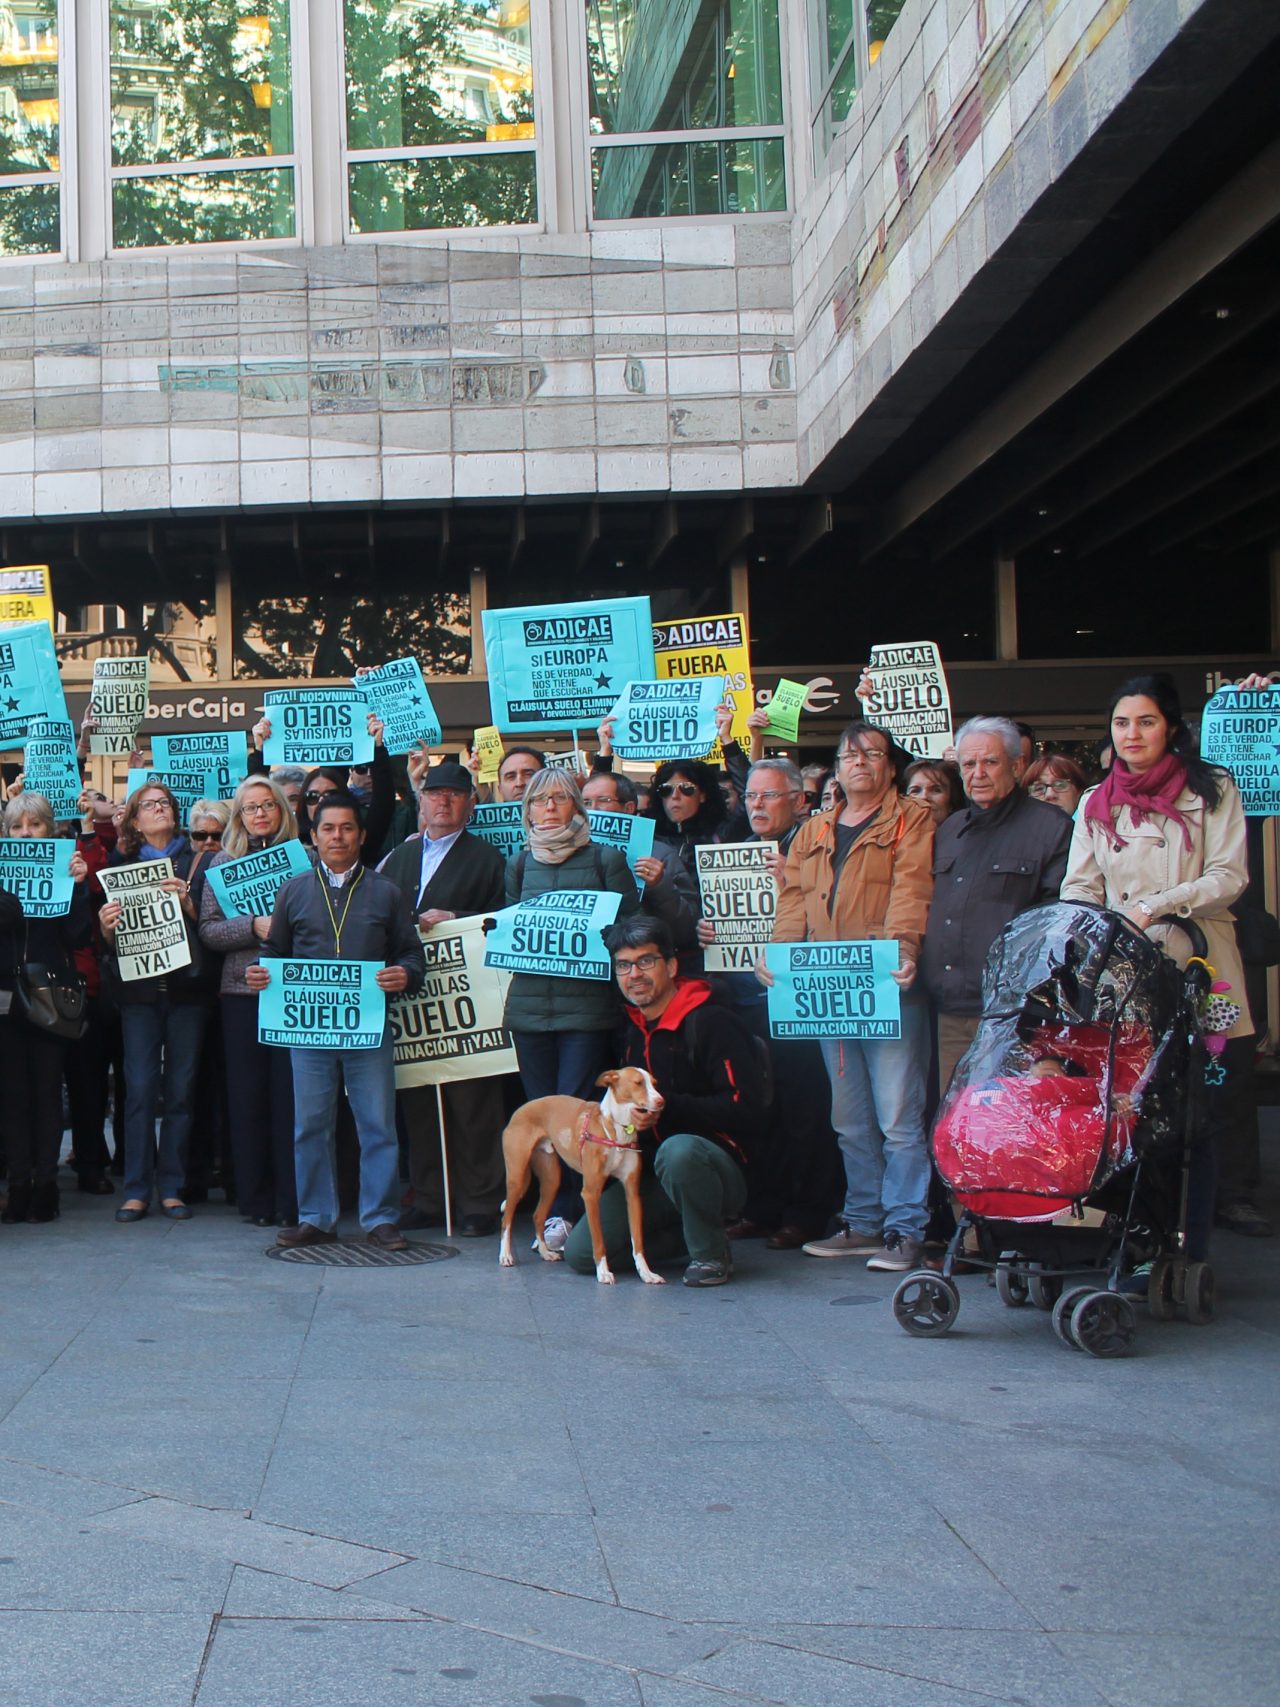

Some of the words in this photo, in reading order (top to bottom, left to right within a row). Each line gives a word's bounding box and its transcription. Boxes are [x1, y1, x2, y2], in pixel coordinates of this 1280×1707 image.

[543, 617, 611, 640] ADICAE
[667, 619, 740, 646] ADICAE
[531, 655, 543, 668] SI
[545, 647, 609, 667] EUROPA
[667, 653, 727, 678] FUERA
[878, 646, 934, 667] ADICAE
[104, 661, 146, 677] ADICAE
[370, 661, 414, 681] ADICAE
[531, 670, 543, 681] ES
[545, 669, 556, 679] DE
[557, 667, 595, 678] VERDAD,
[93, 682, 146, 695] CLÁUSULAS
[375, 680, 416, 699] EUROPA
[532, 679, 551, 689] NOS
[553, 678, 577, 688] TIENE
[533, 688, 549, 698] QUE
[551, 686, 594, 696] ESCUCHAR
[645, 683, 701, 698] ADICAE
[92, 693, 146, 715] SUELO
[510, 700, 554, 713] CLÁUSULA
[554, 700, 581, 710] SUELO
[776, 695, 800, 708] SUELO
[868, 685, 942, 714] SUELO
[283, 704, 352, 728] SUELO
[588, 708, 608, 716] TOTAL
[628, 704, 698, 720] CLÁUSULAS
[32, 722, 72, 737] ADICAE
[284, 726, 353, 742] CLÁUSULAS
[391, 721, 418, 734] SUELO
[628, 718, 699, 744] SUELO
[922, 724, 947, 733] TOTAL
[1208, 722, 1221, 734] SI
[181, 735, 229, 752] ADICAE
[1208, 735, 1218, 744] ES
[1221, 735, 1233, 744] DE
[1235, 735, 1274, 745] VERDAD,
[1208, 745, 1227, 753] NOS
[1229, 744, 1255, 753] TIENE
[30, 743, 73, 757] EUROPA
[285, 749, 338, 762] ADICAE
[613, 744, 680, 759] ELIMINACIÓN
[1226, 753, 1271, 762] ESCUCHAR
[169, 755, 229, 771] CLÁUSULAS
[24, 778, 76, 791] CLÁUSULAS
[0, 842, 54, 858] ADICAE
[235, 849, 288, 880] ADICAE
[116, 864, 168, 887] ADICAE
[701, 875, 773, 893] CLÁUSULAS
[535, 894, 597, 910] ADICAE
[703, 891, 775, 918] SUELO
[117, 900, 176, 933] SUELO
[513, 911, 589, 931] CLÁUSULAS
[118, 922, 182, 948] ELIMINACIÓN
[511, 927, 588, 958] SUELO
[134, 950, 172, 976] ¡YA!
[489, 953, 567, 972] ELIMINACIÓN
[570, 962, 604, 976] ¡¡YA!!
[807, 946, 872, 965] ADICAE
[300, 964, 360, 982] ADICAE
[792, 973, 875, 991] CLÁUSULAS
[283, 987, 361, 1006] CLÁUSULAS
[794, 989, 876, 1019] SUELO
[283, 1003, 361, 1031] SUELO
[389, 995, 477, 1041] SUELO
[777, 1020, 858, 1035] ELIMINACIÓN
[861, 1022, 894, 1037] ¡¡YA!!
[264, 1030, 340, 1046] ELIMINACIÓN
[343, 1034, 376, 1048] ¡¡YA!!
[462, 1030, 504, 1055] ¡¡YA!!
